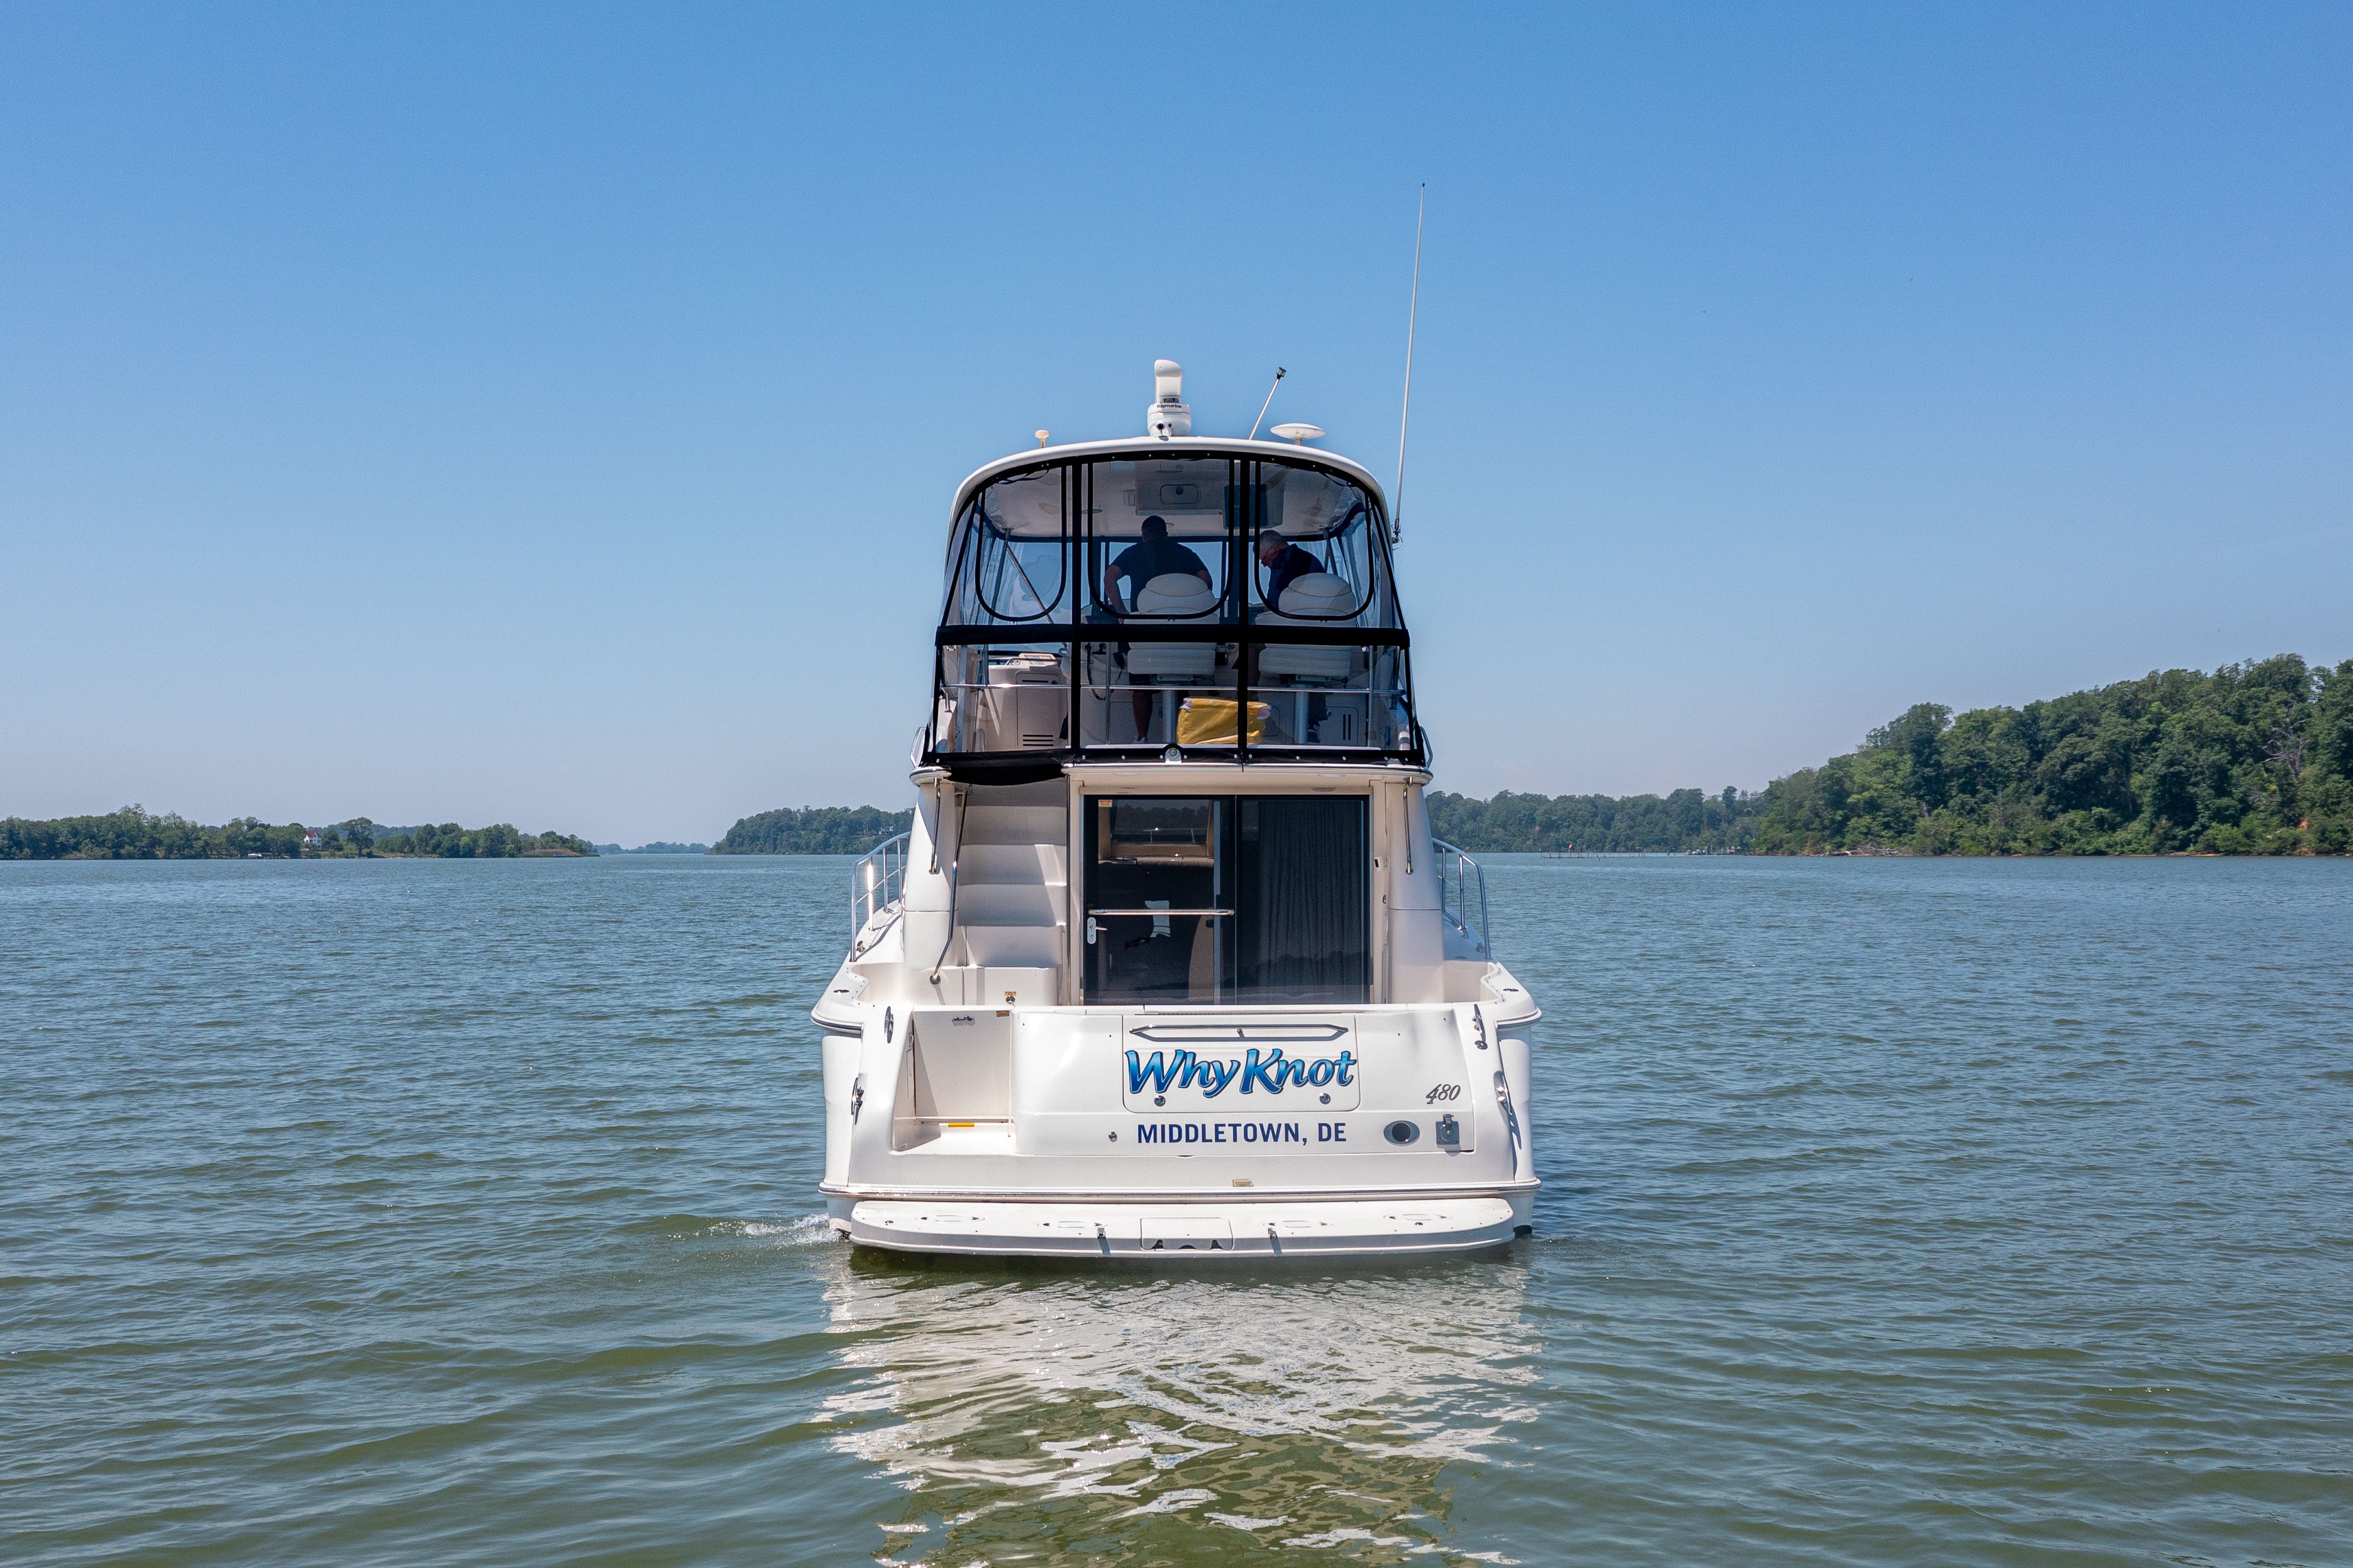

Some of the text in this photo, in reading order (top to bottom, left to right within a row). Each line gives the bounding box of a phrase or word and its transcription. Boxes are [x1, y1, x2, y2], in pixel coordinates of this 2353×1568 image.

[1426, 1083, 1461, 1104] 480
[1138, 1123, 1347, 1146] MIDDLETOWN, DE
